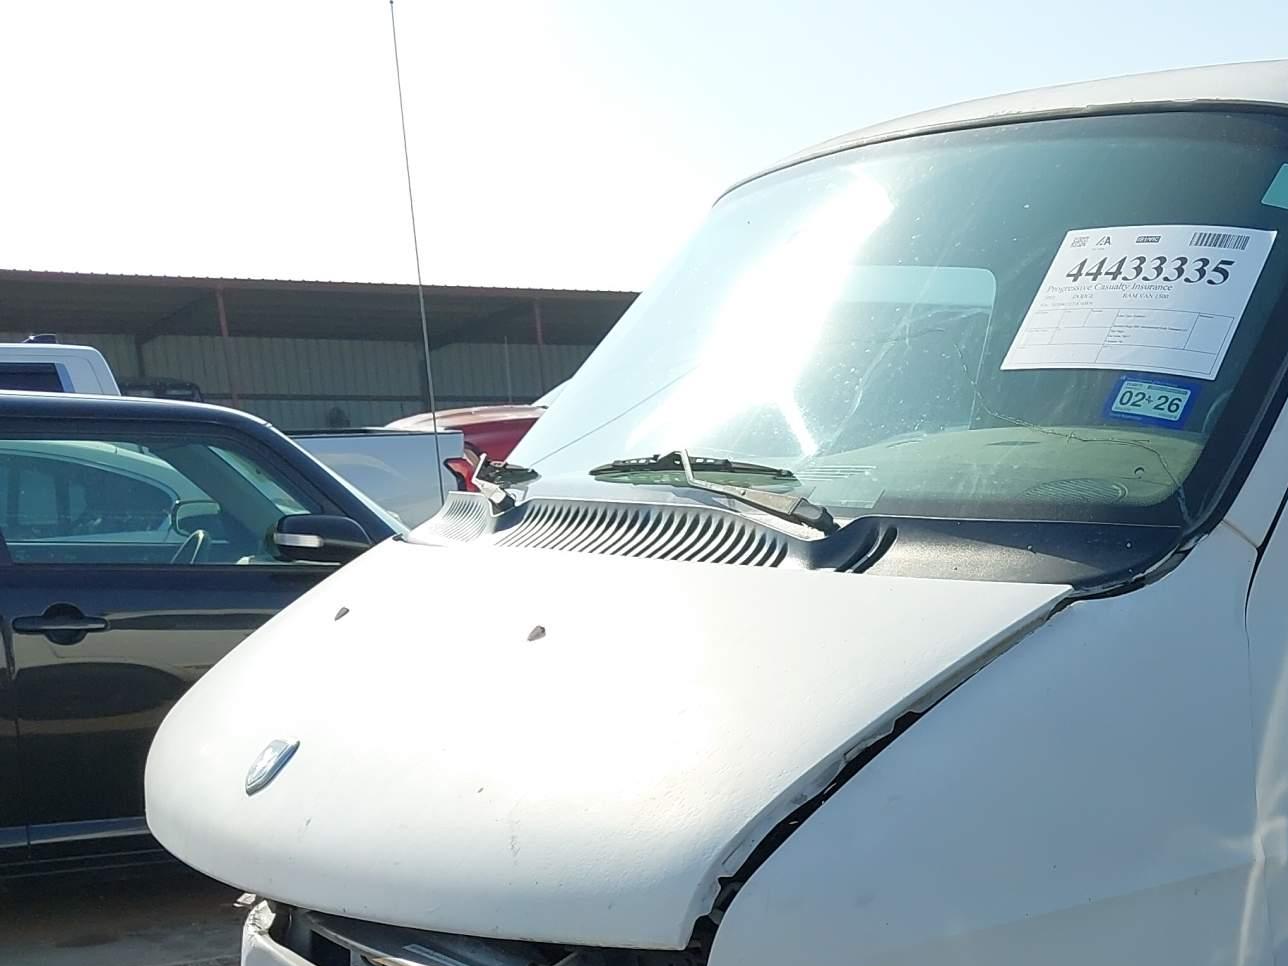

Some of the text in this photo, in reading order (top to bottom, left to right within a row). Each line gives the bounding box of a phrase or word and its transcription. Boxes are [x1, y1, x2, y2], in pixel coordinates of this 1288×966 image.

[1066, 255, 1235, 285] 44433335
[1094, 282, 1130, 292] Casualty
[1131, 282, 1173, 291] Insurance
[1119, 390, 1182, 413] 02 26
